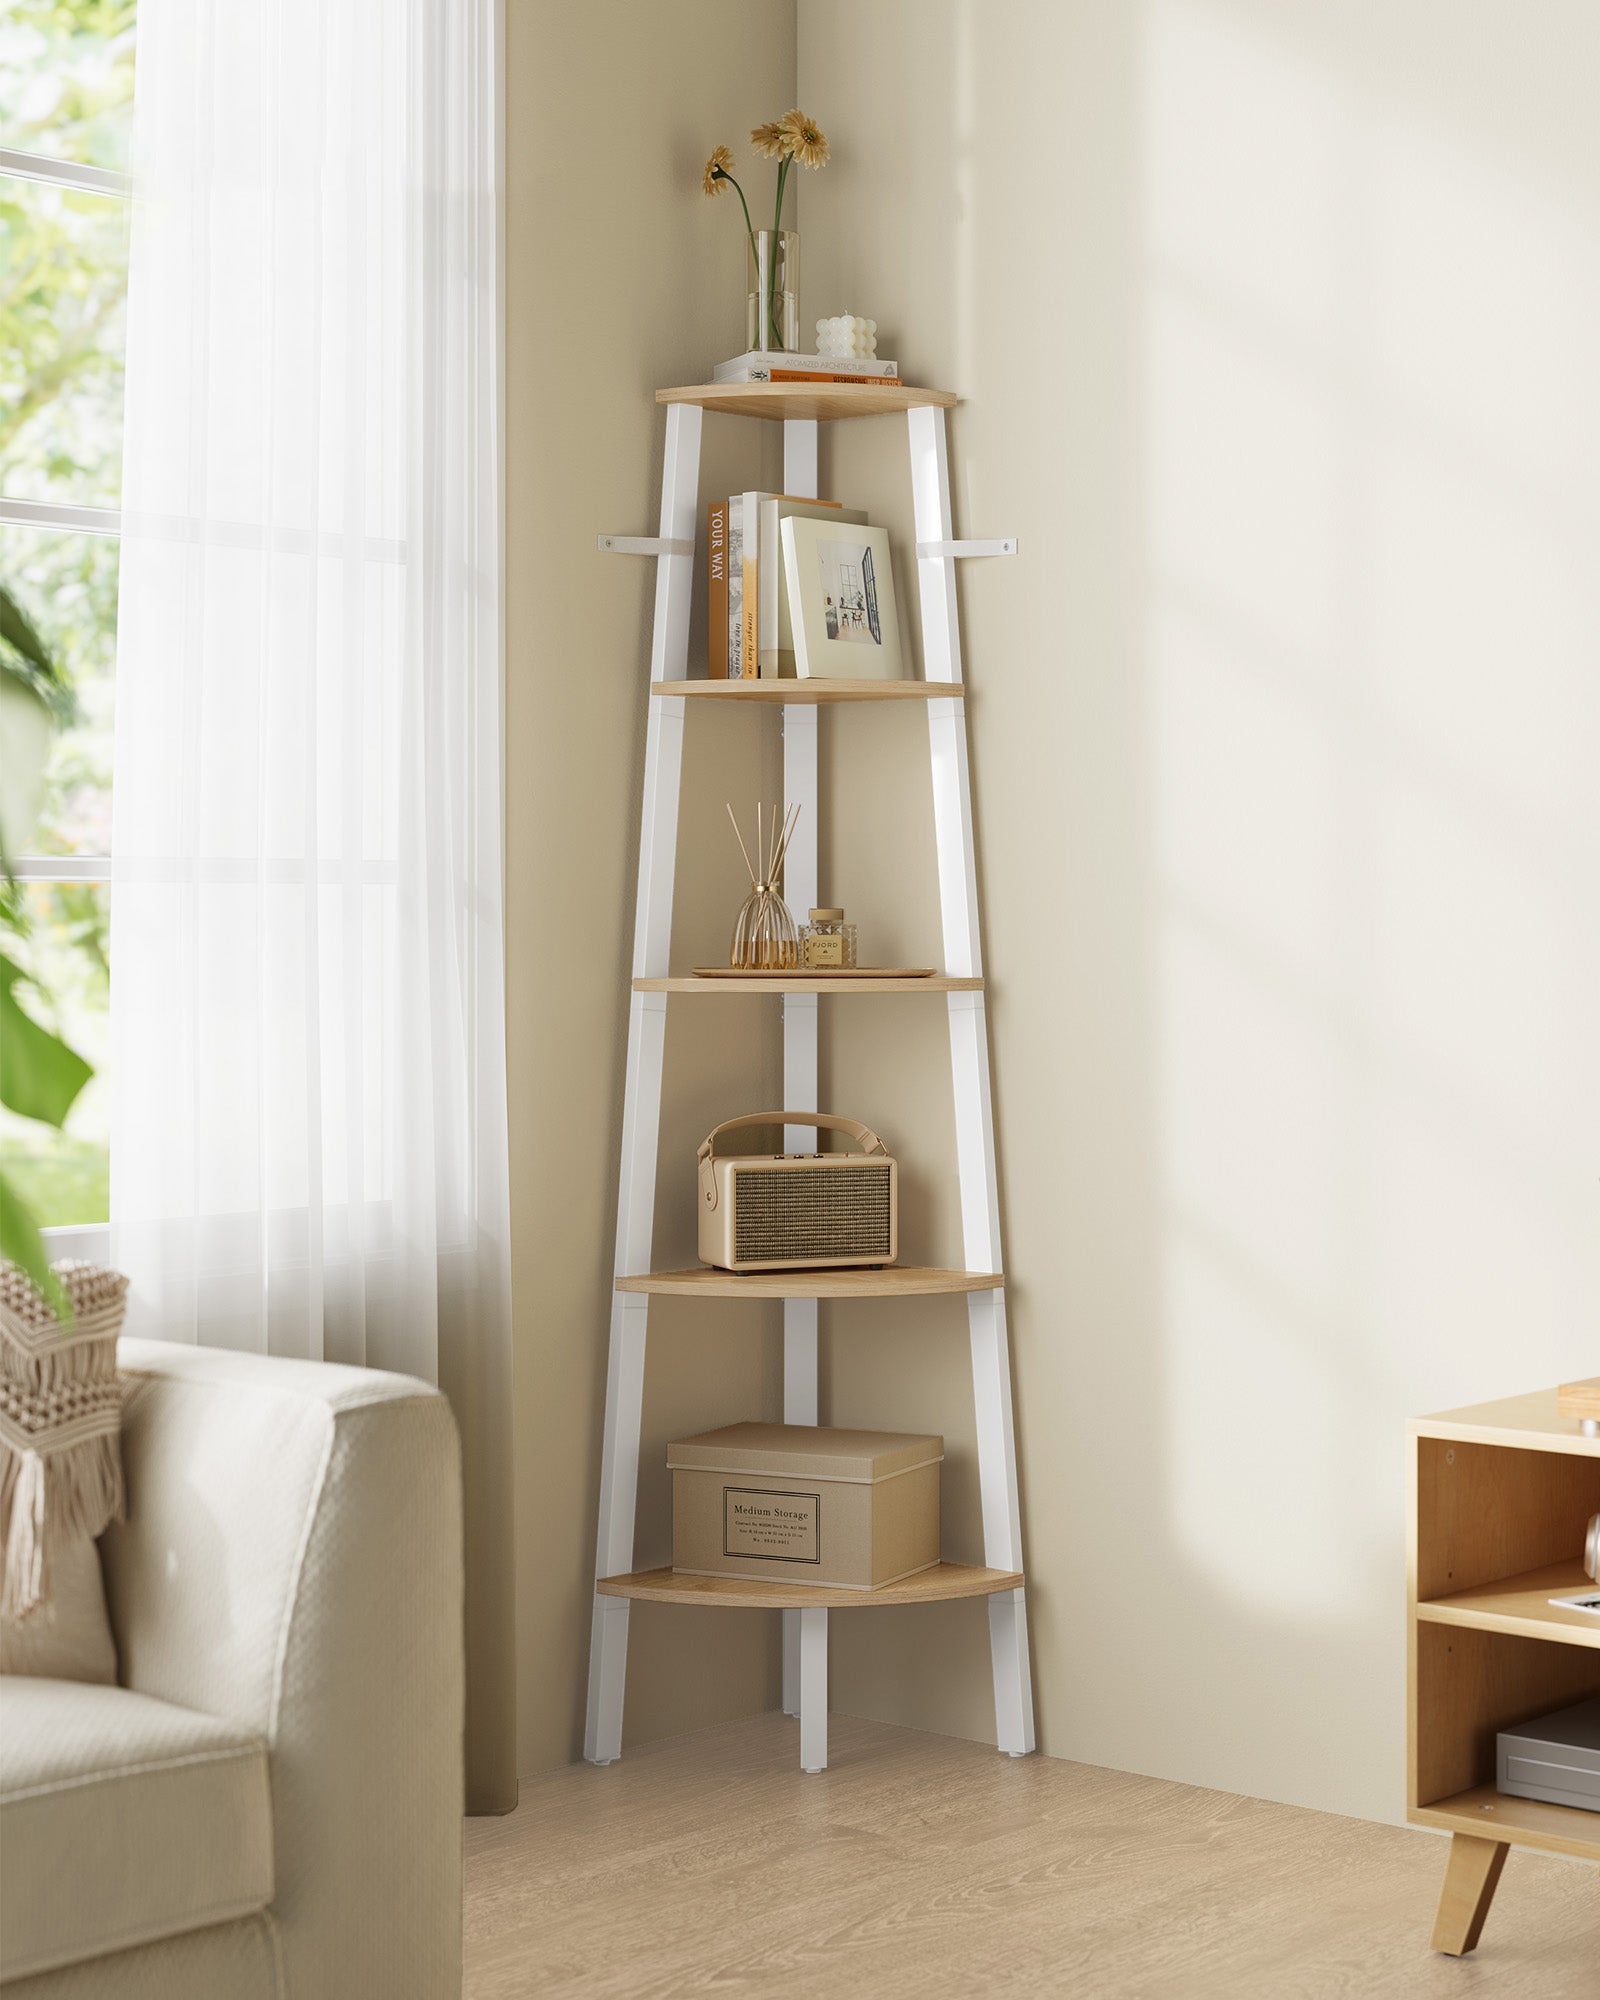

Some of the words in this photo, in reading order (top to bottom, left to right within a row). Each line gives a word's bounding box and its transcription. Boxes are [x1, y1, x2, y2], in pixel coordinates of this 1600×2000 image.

[785, 359, 819, 369] ATOMIZED
[820, 361, 867, 373] ARCHITECTURE
[711, 509, 723, 549] YOUR
[711, 551, 723, 581] WAY
[734, 1504, 771, 1516] Medium
[774, 1507, 809, 1521] Storage
